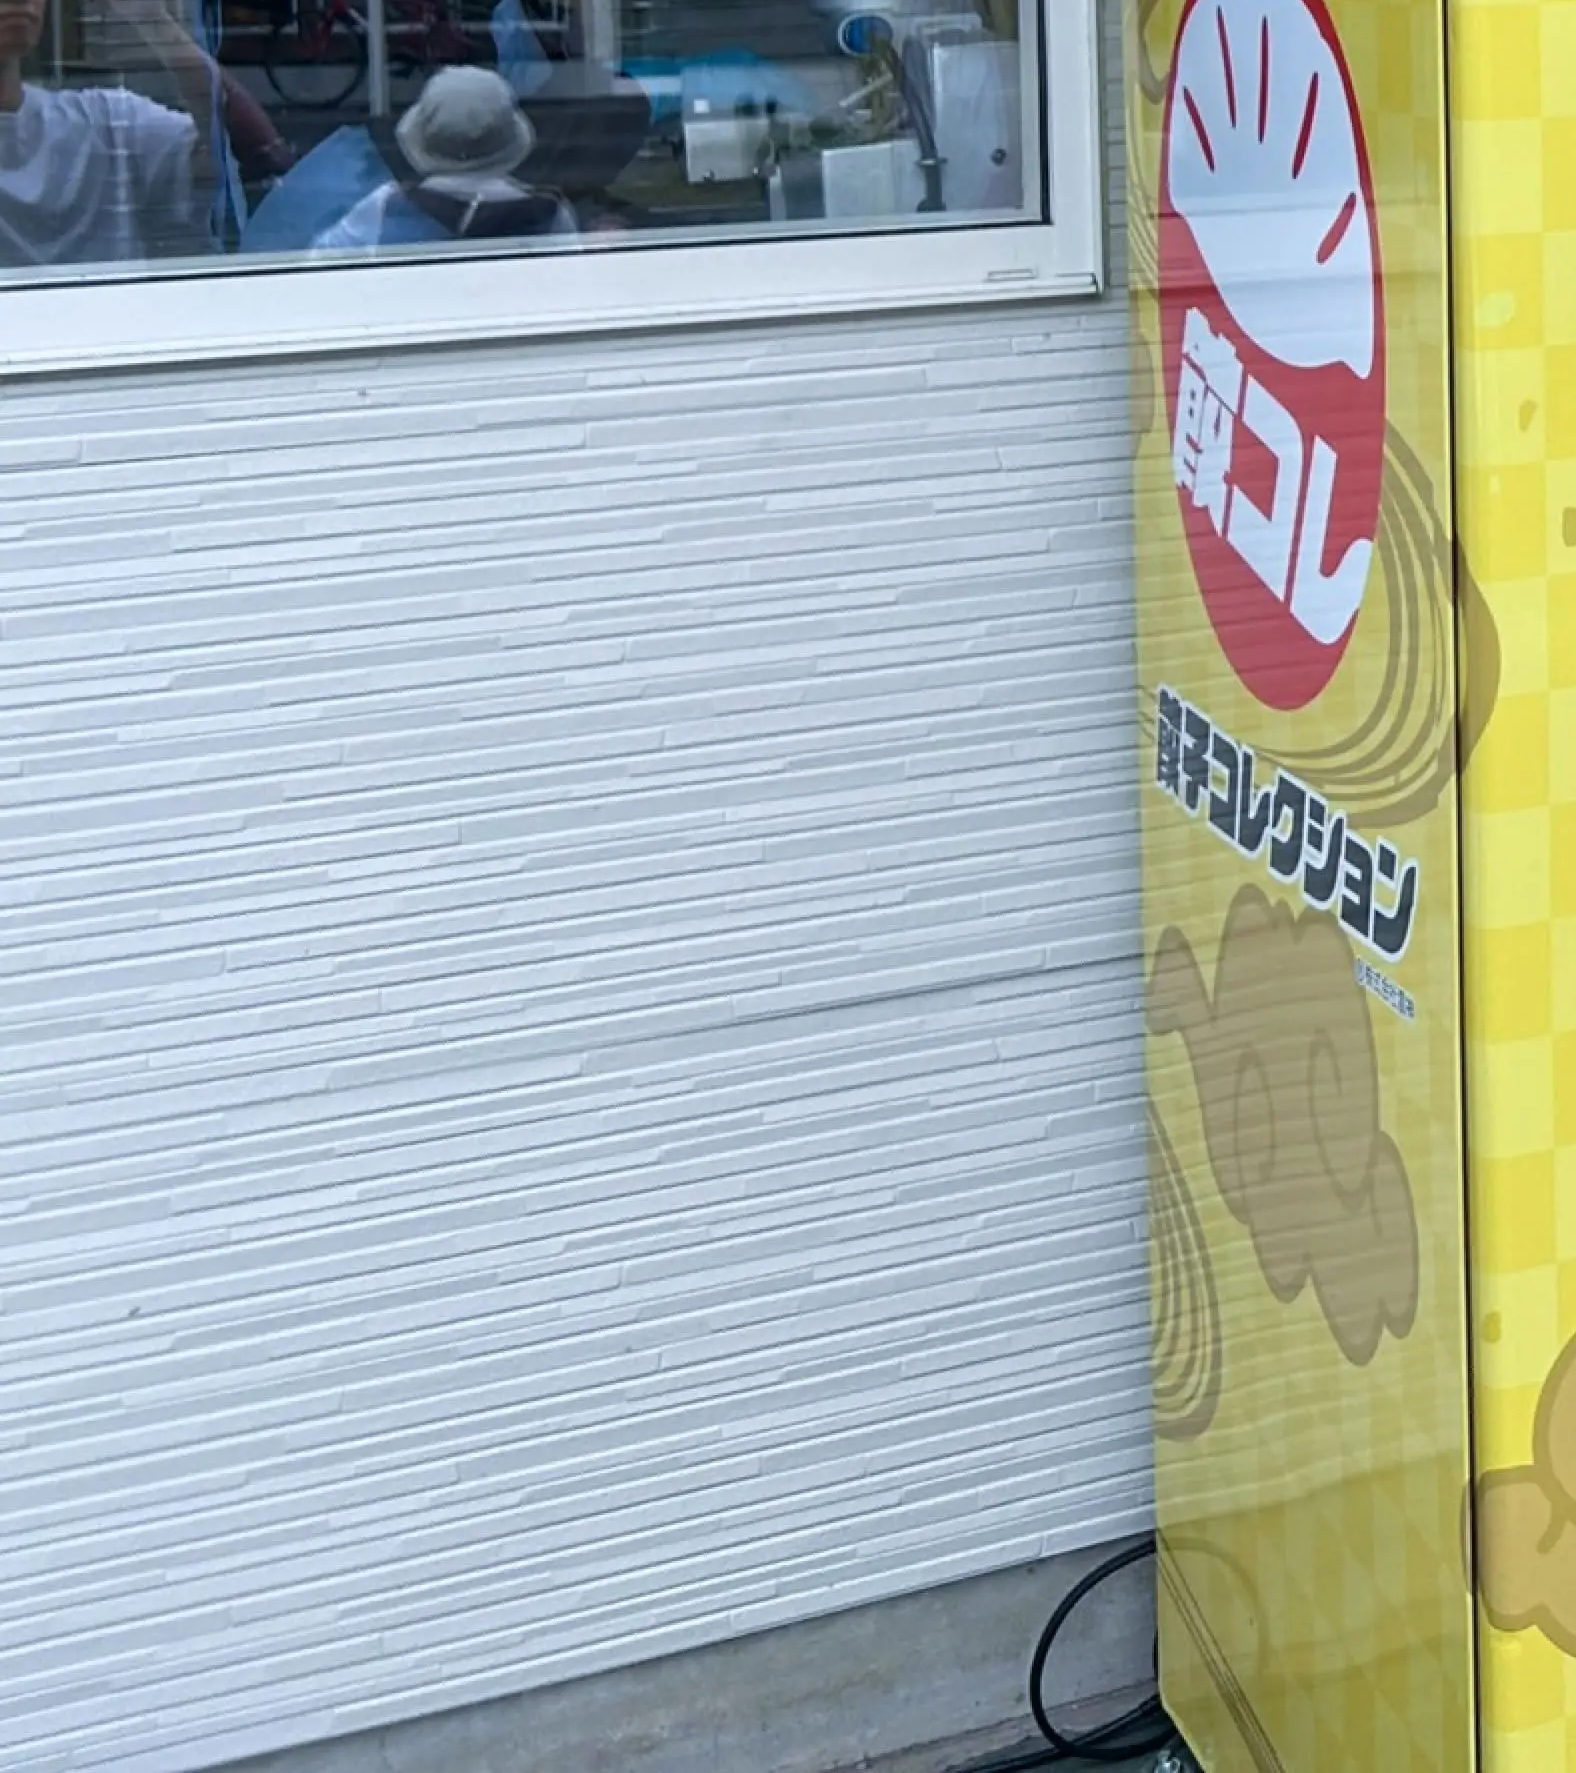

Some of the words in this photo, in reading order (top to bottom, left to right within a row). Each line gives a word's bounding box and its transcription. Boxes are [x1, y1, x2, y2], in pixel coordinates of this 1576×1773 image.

[1171, 306, 1375, 644] 餃コレ
[1157, 688, 1417, 959] 餃子コレクション
